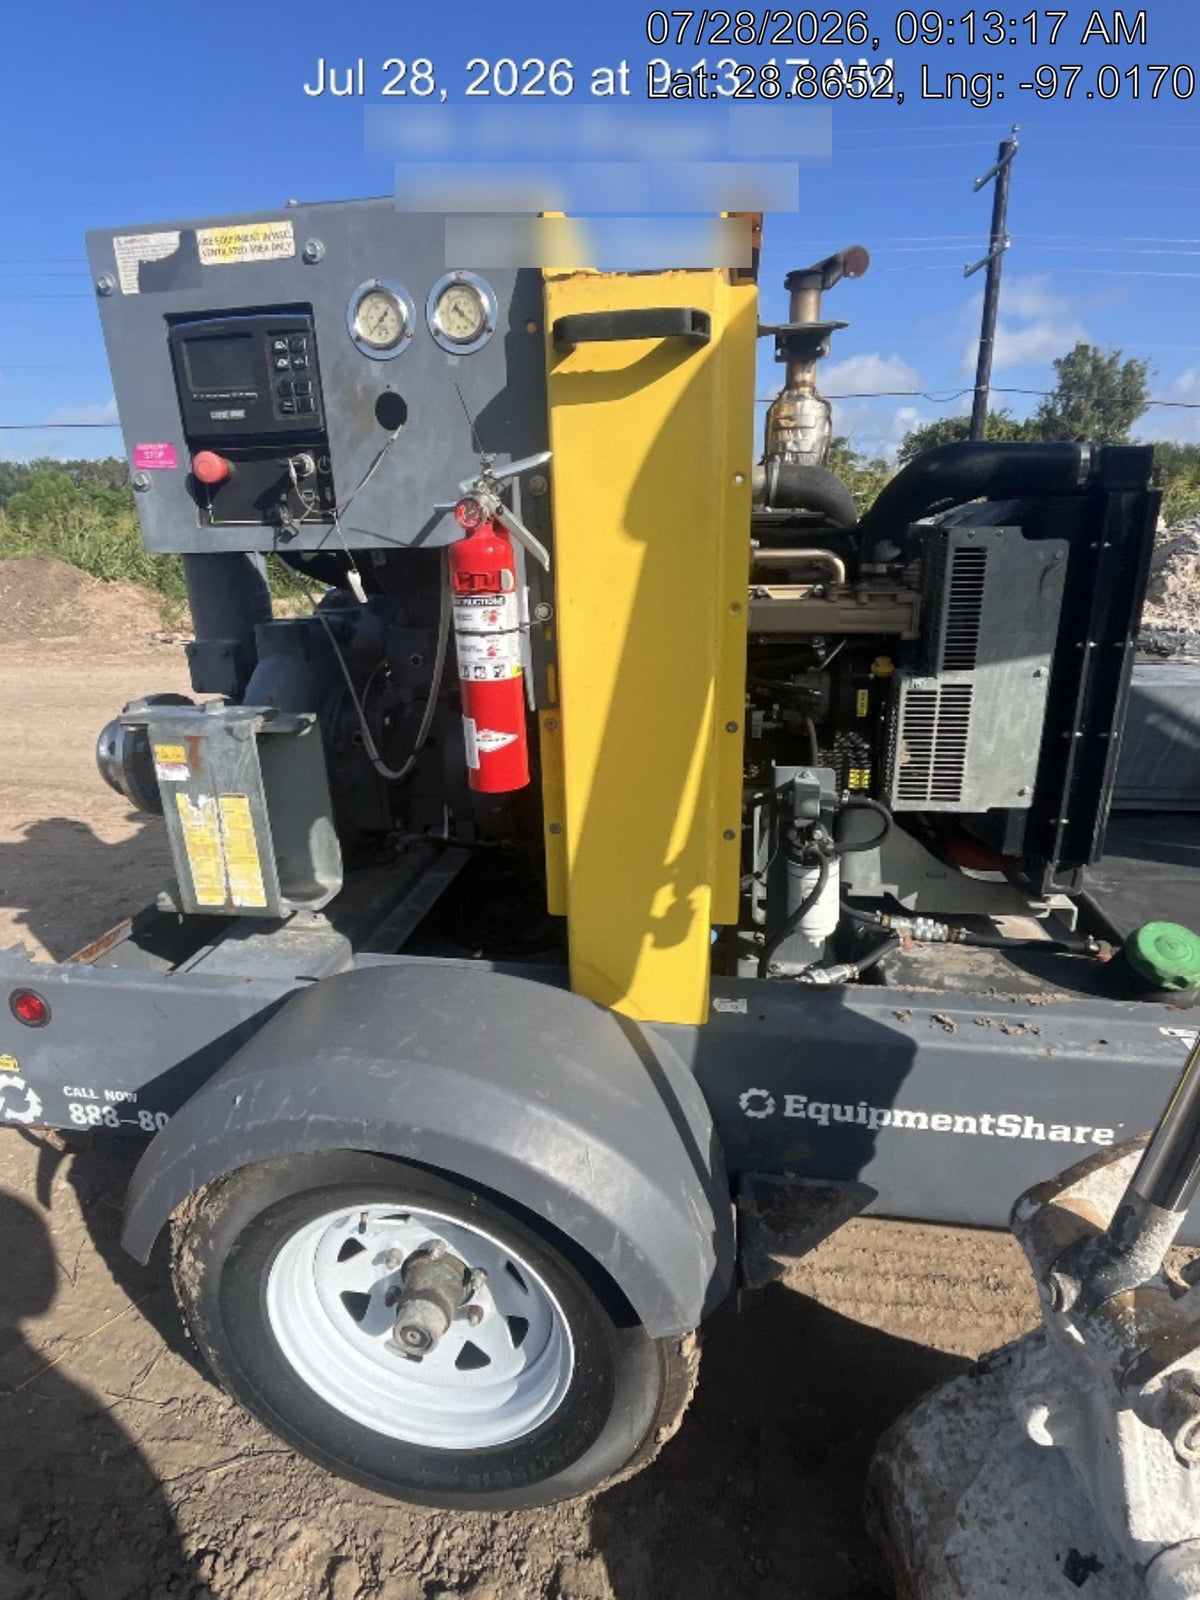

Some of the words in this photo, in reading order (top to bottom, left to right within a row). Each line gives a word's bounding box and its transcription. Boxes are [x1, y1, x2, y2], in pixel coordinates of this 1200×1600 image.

[63, 1085, 100, 1100] CALL
[104, 1089, 138, 1103] NOW
[783, 1094, 1115, 1146] EquipmentShare
